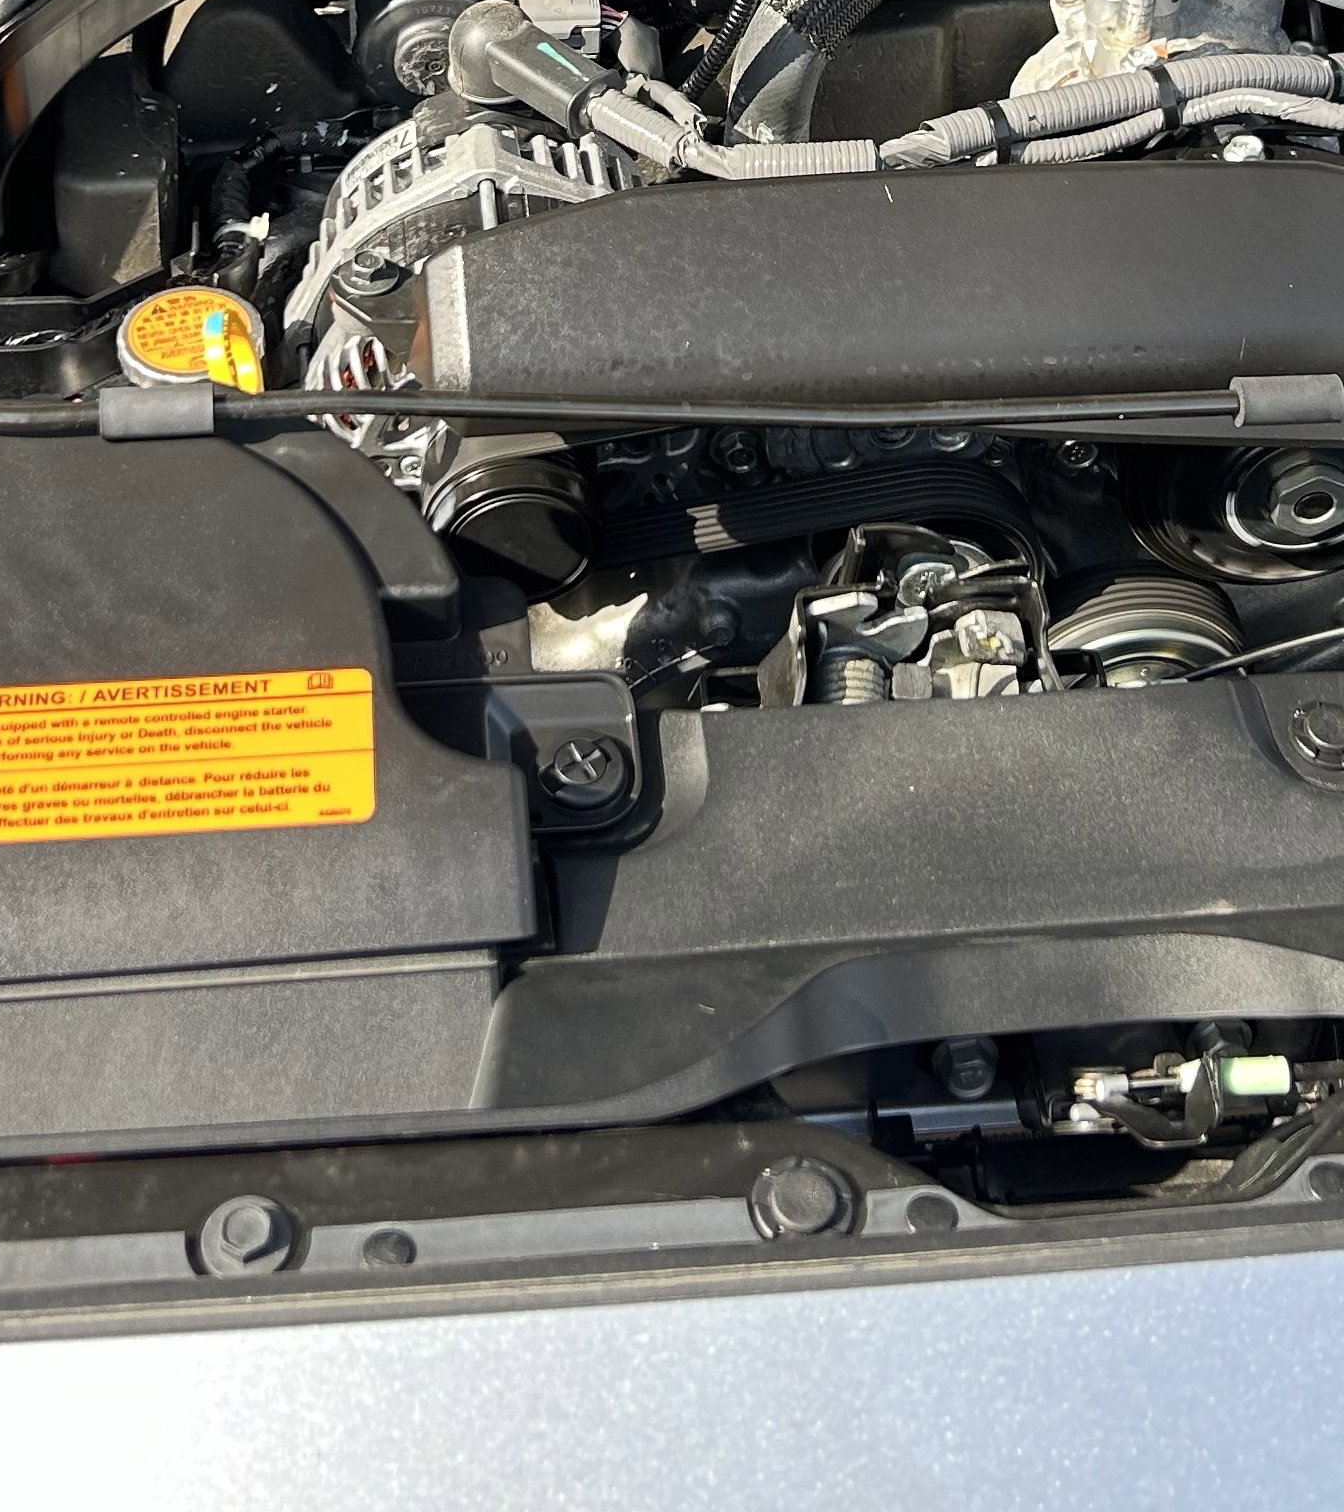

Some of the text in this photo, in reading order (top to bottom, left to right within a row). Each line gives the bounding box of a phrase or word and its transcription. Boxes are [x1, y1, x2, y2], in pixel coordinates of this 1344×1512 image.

[93, 680, 270, 701] AVERTISSEMENT
[50, 717, 77, 728] with
[94, 714, 139, 726] remote
[144, 710, 210, 723] controlled
[215, 708, 258, 721] engine
[24, 733, 73, 744] serious
[184, 723, 256, 736] disconnect
[261, 722, 281, 731] the
[286, 719, 332, 730] vehicle
[58, 750, 80, 760] any
[86, 745, 133, 756] service
[159, 742, 180, 752] the
[52, 778, 119, 791] démarreur
[204, 772, 234, 783] Pour
[240, 769, 285, 781] réduire
[290, 767, 309, 778] les
[22, 800, 67, 811] graves
[165, 788, 238, 801] débrancher
[259, 784, 308, 796] batterie
[54, 813, 78, 824] des
[83, 809, 132, 822] travaux
[138, 805, 209, 819] d'entretien
[214, 806, 234, 815] sur
